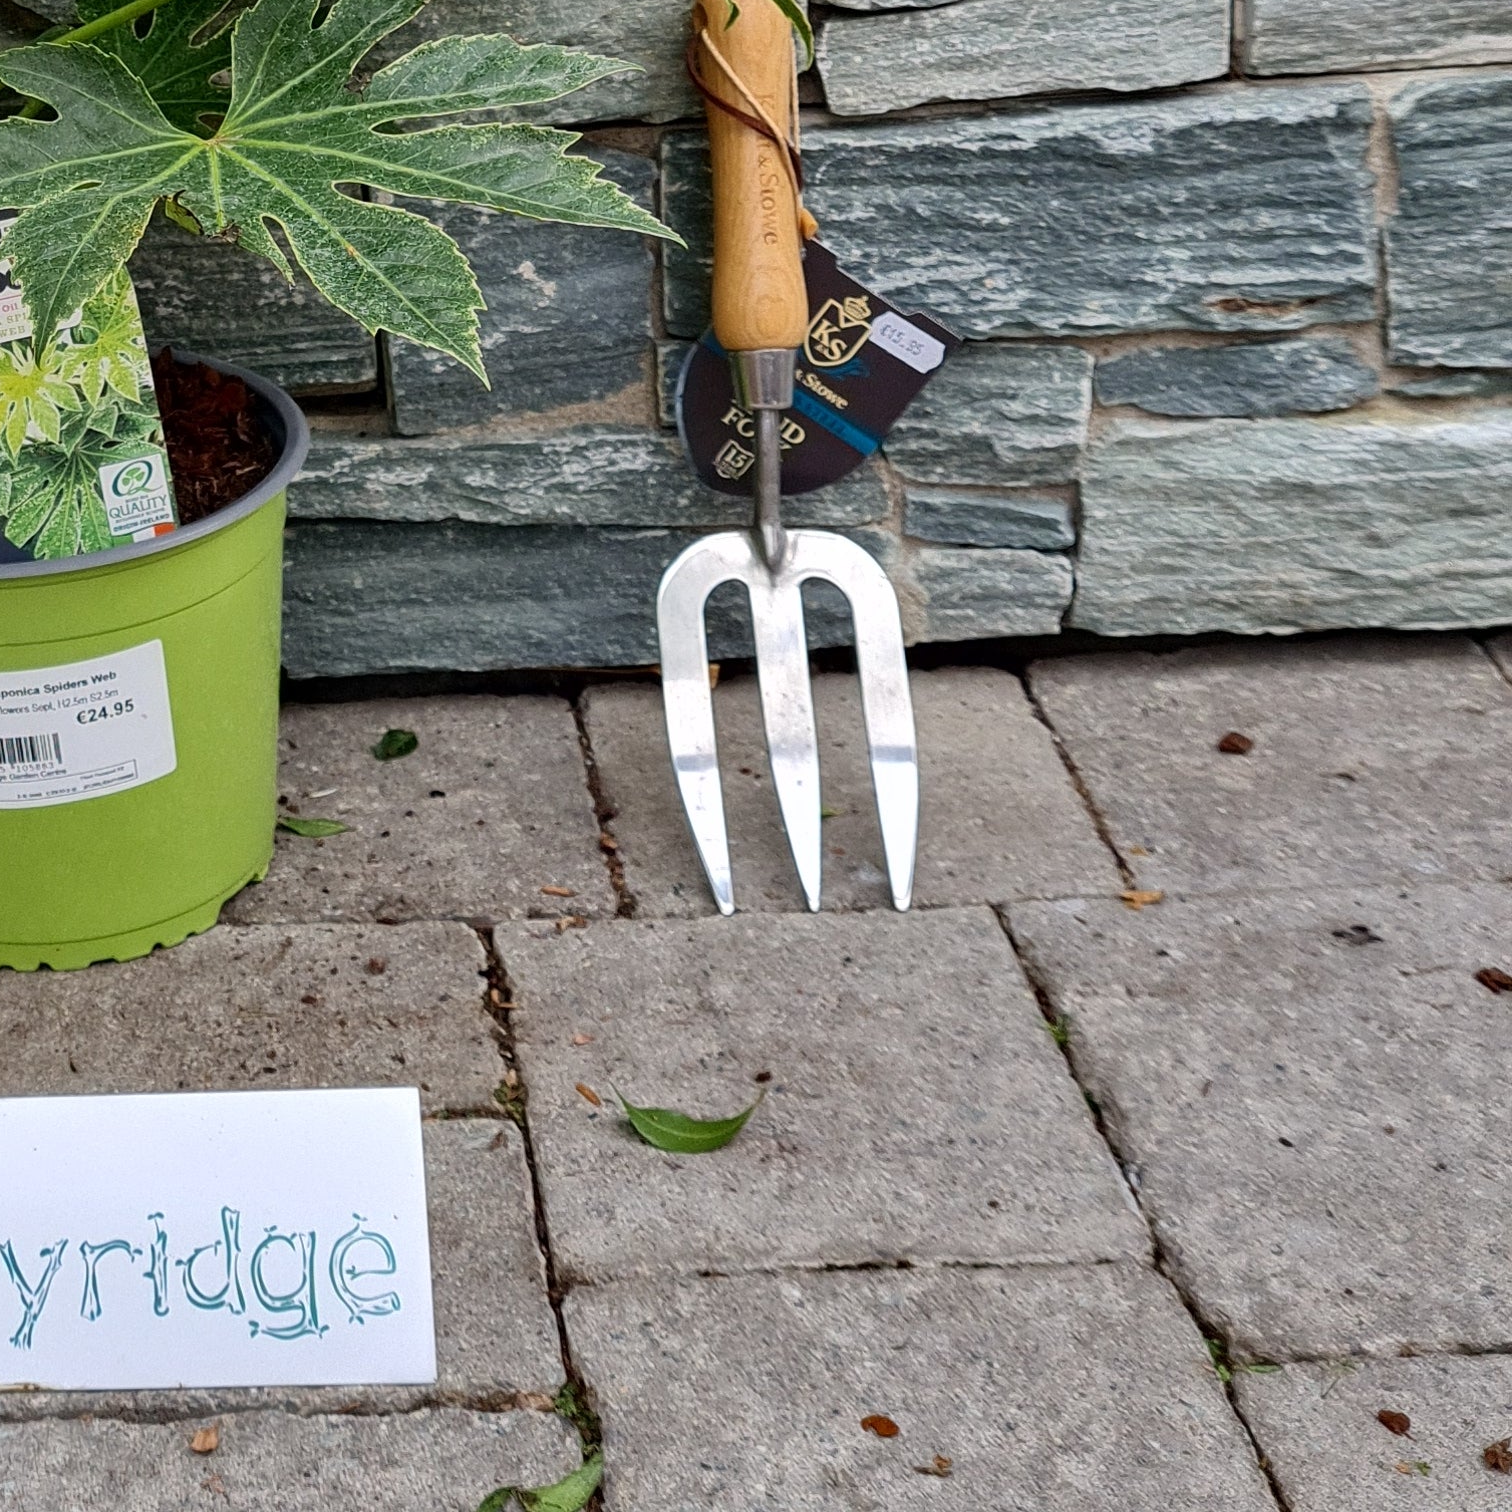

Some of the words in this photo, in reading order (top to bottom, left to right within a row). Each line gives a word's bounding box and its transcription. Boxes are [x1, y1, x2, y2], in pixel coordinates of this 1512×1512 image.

[760, 173, 780, 245] Stowe
[1, 302, 18, 314] Oil
[802, 372, 849, 410] Stowe
[723, 448, 748, 468] 15
[109, 494, 168, 519] QUALITY
[43, 679, 89, 695] Spiders
[90, 671, 118, 685] Web
[76, 697, 135, 725] €24.95
